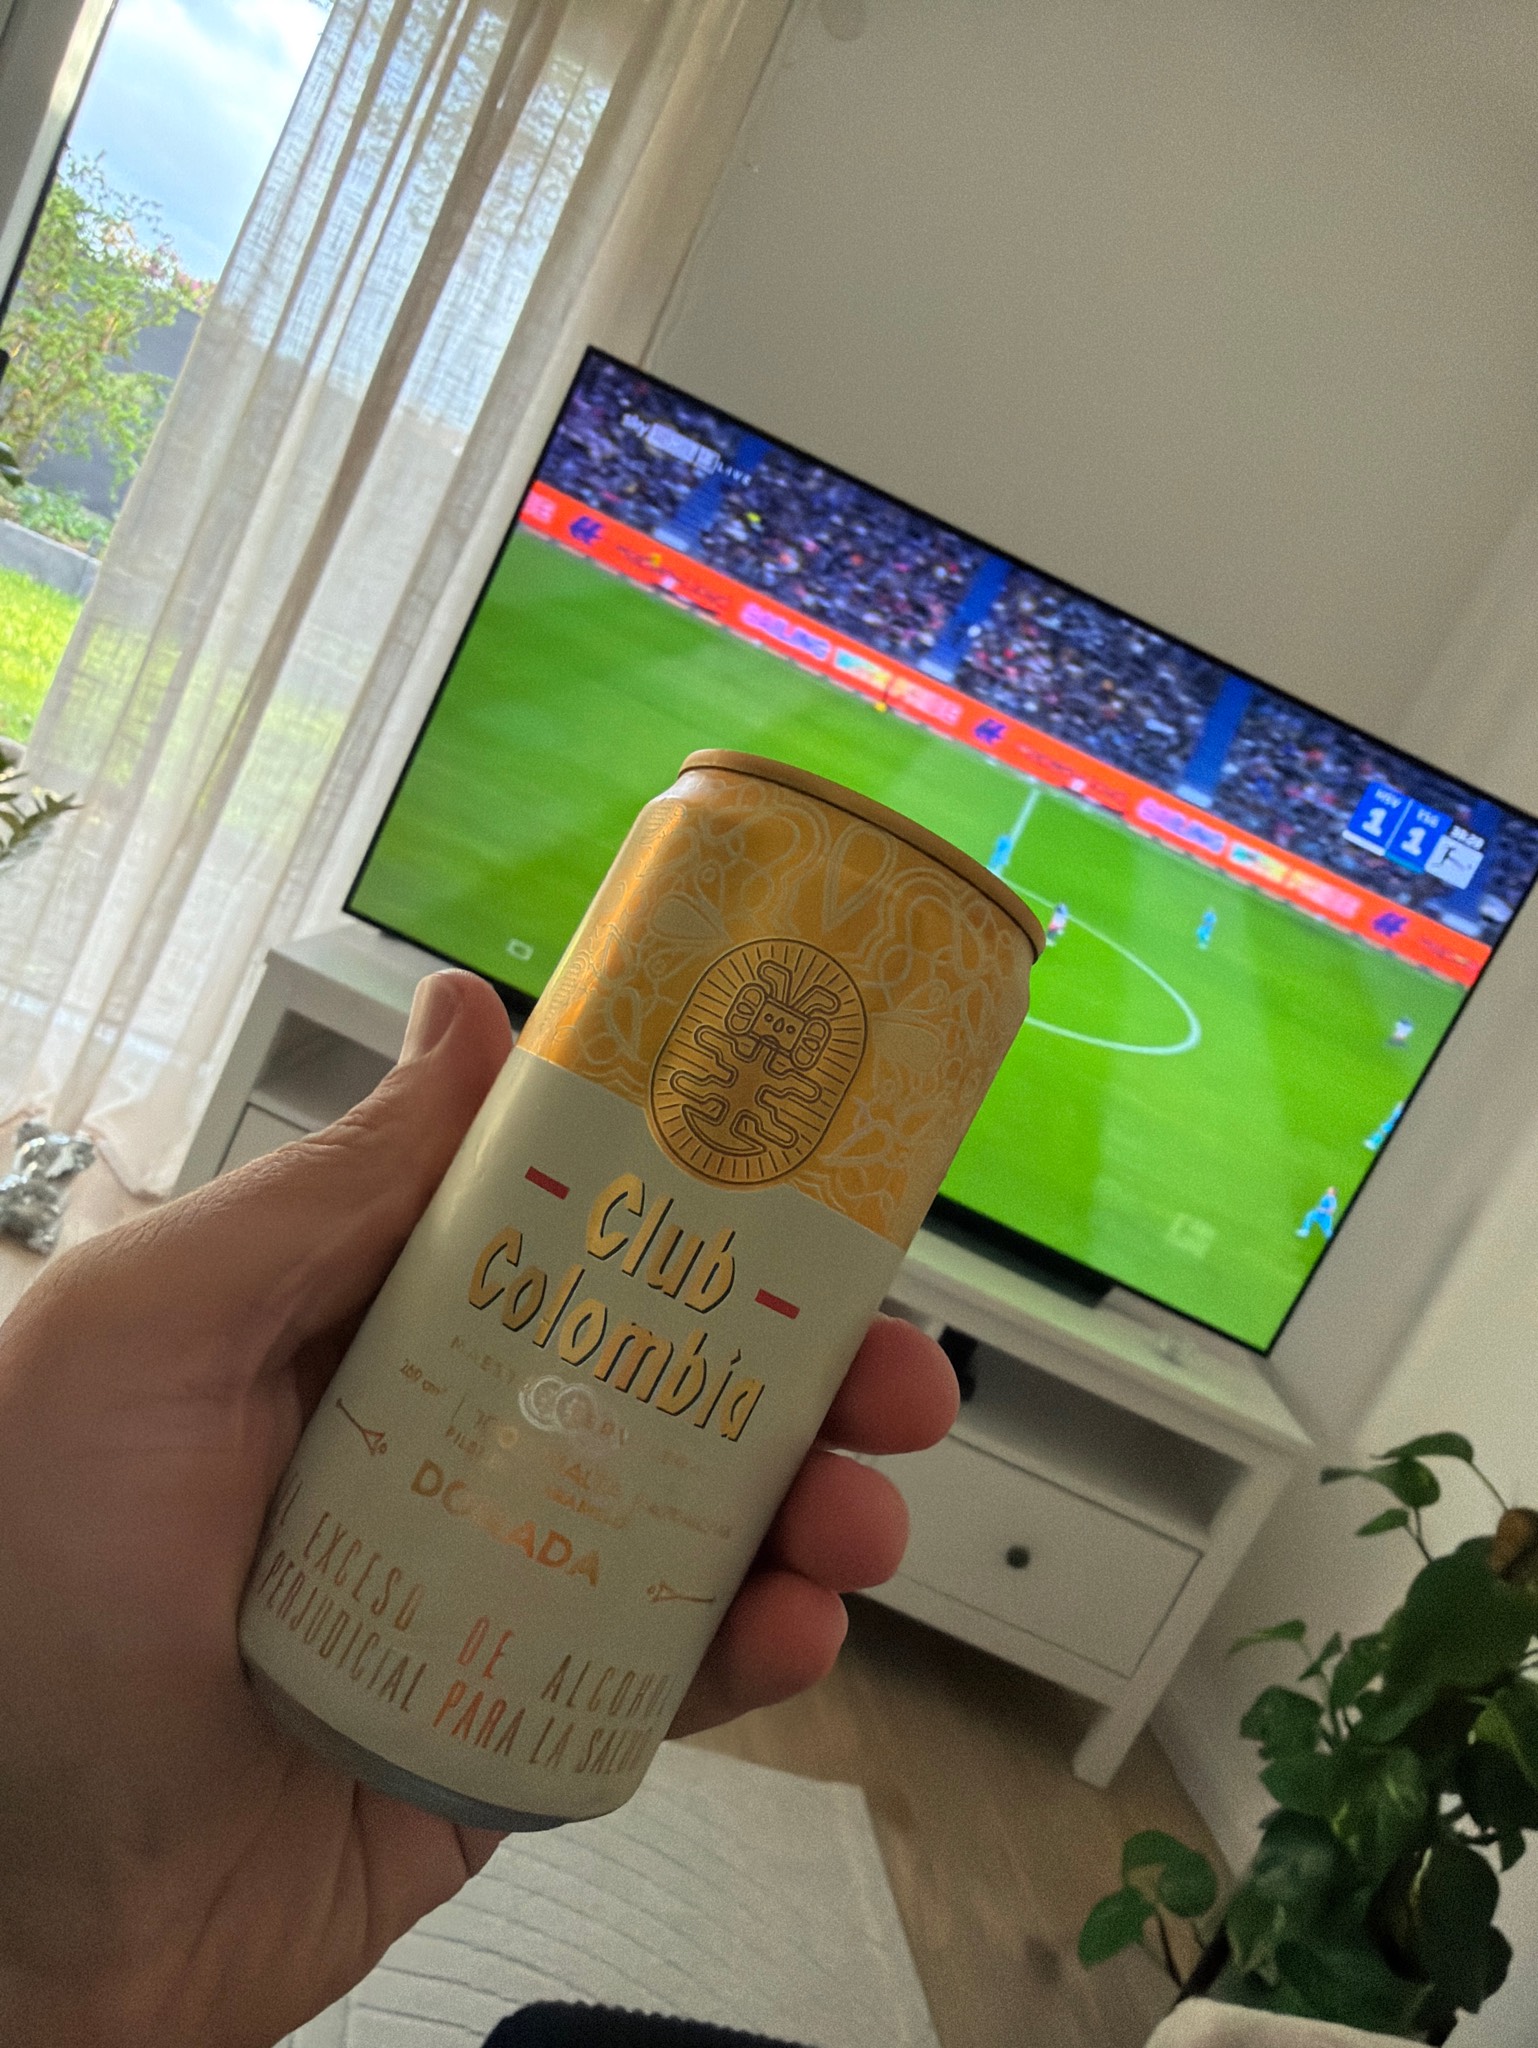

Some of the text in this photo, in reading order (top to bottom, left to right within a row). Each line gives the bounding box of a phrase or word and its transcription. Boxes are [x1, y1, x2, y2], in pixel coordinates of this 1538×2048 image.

[1361, 807, 1427, 857] 1 1
[585, 1173, 738, 1314] Club
[468, 1225, 766, 1442] Colombia
[303, 1510, 427, 1633] EXCESO
[456, 1614, 514, 1681] DE
[409, 1458, 600, 1589] DOADA
[258, 1550, 429, 1714] PERJUDICIAL
[431, 1679, 527, 1757] PARA
[528, 1716, 575, 1769] LA
